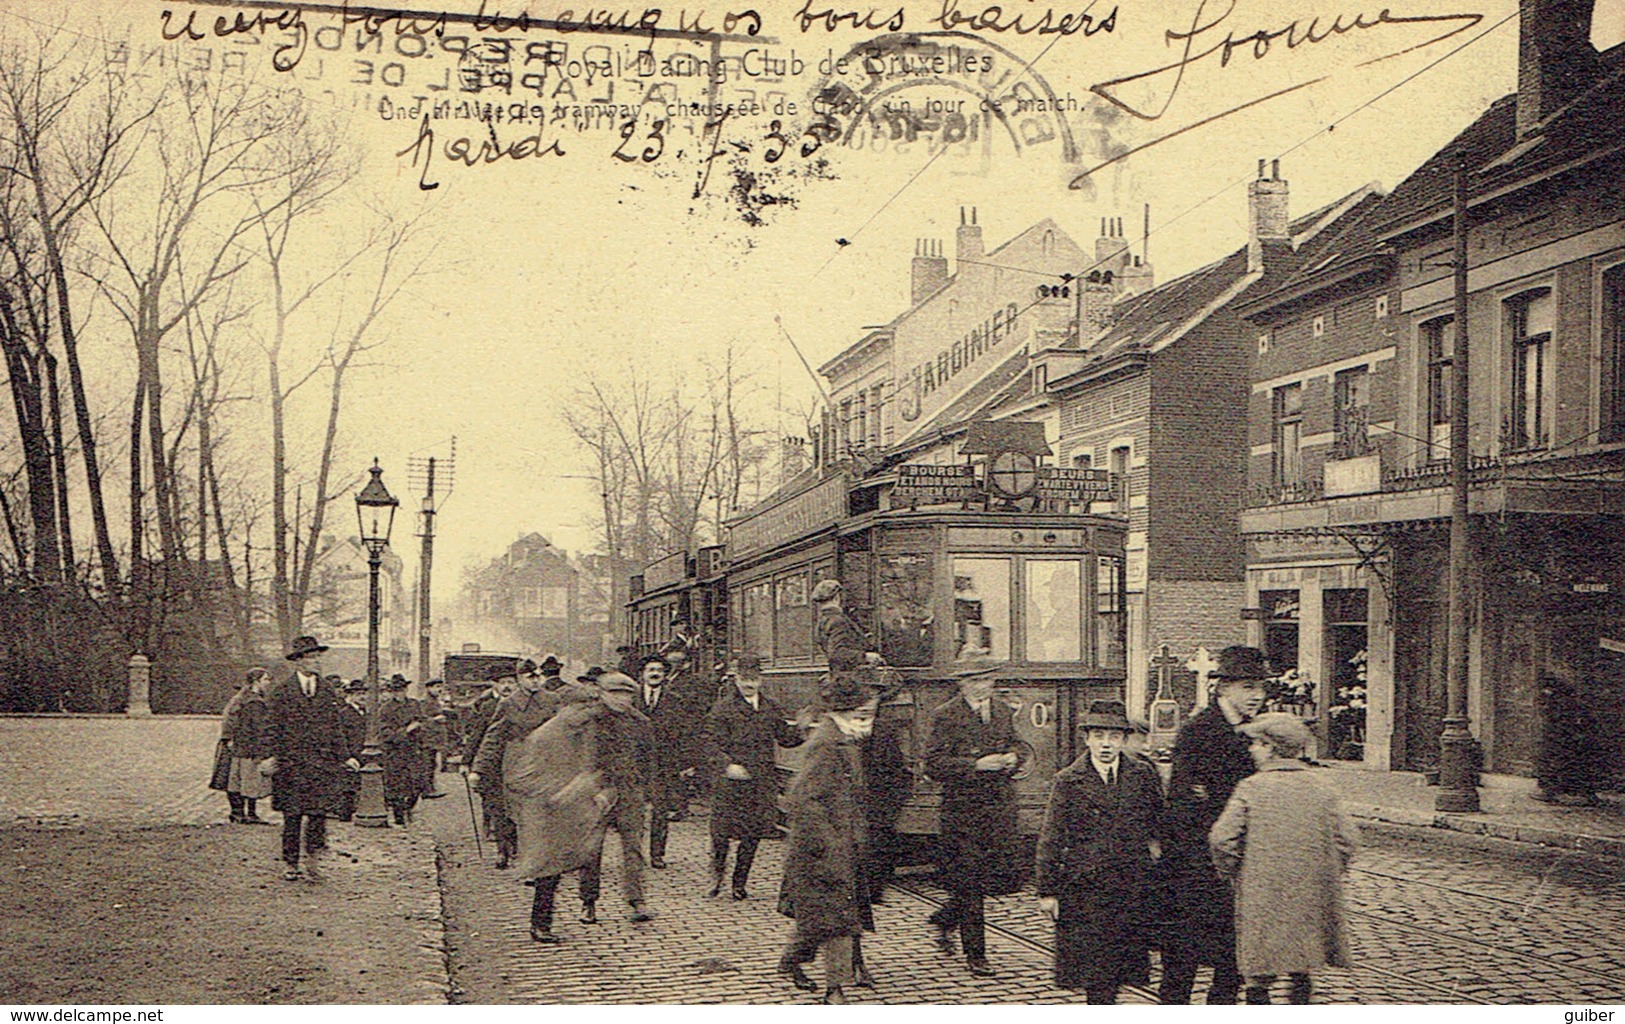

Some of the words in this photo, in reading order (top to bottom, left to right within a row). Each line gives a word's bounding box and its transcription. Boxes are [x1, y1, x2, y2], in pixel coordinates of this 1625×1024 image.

[929, 0, 1119, 37] baisers
[902, 302, 1018, 421] JARDINIER
[909, 466, 965, 476] BOURSE
